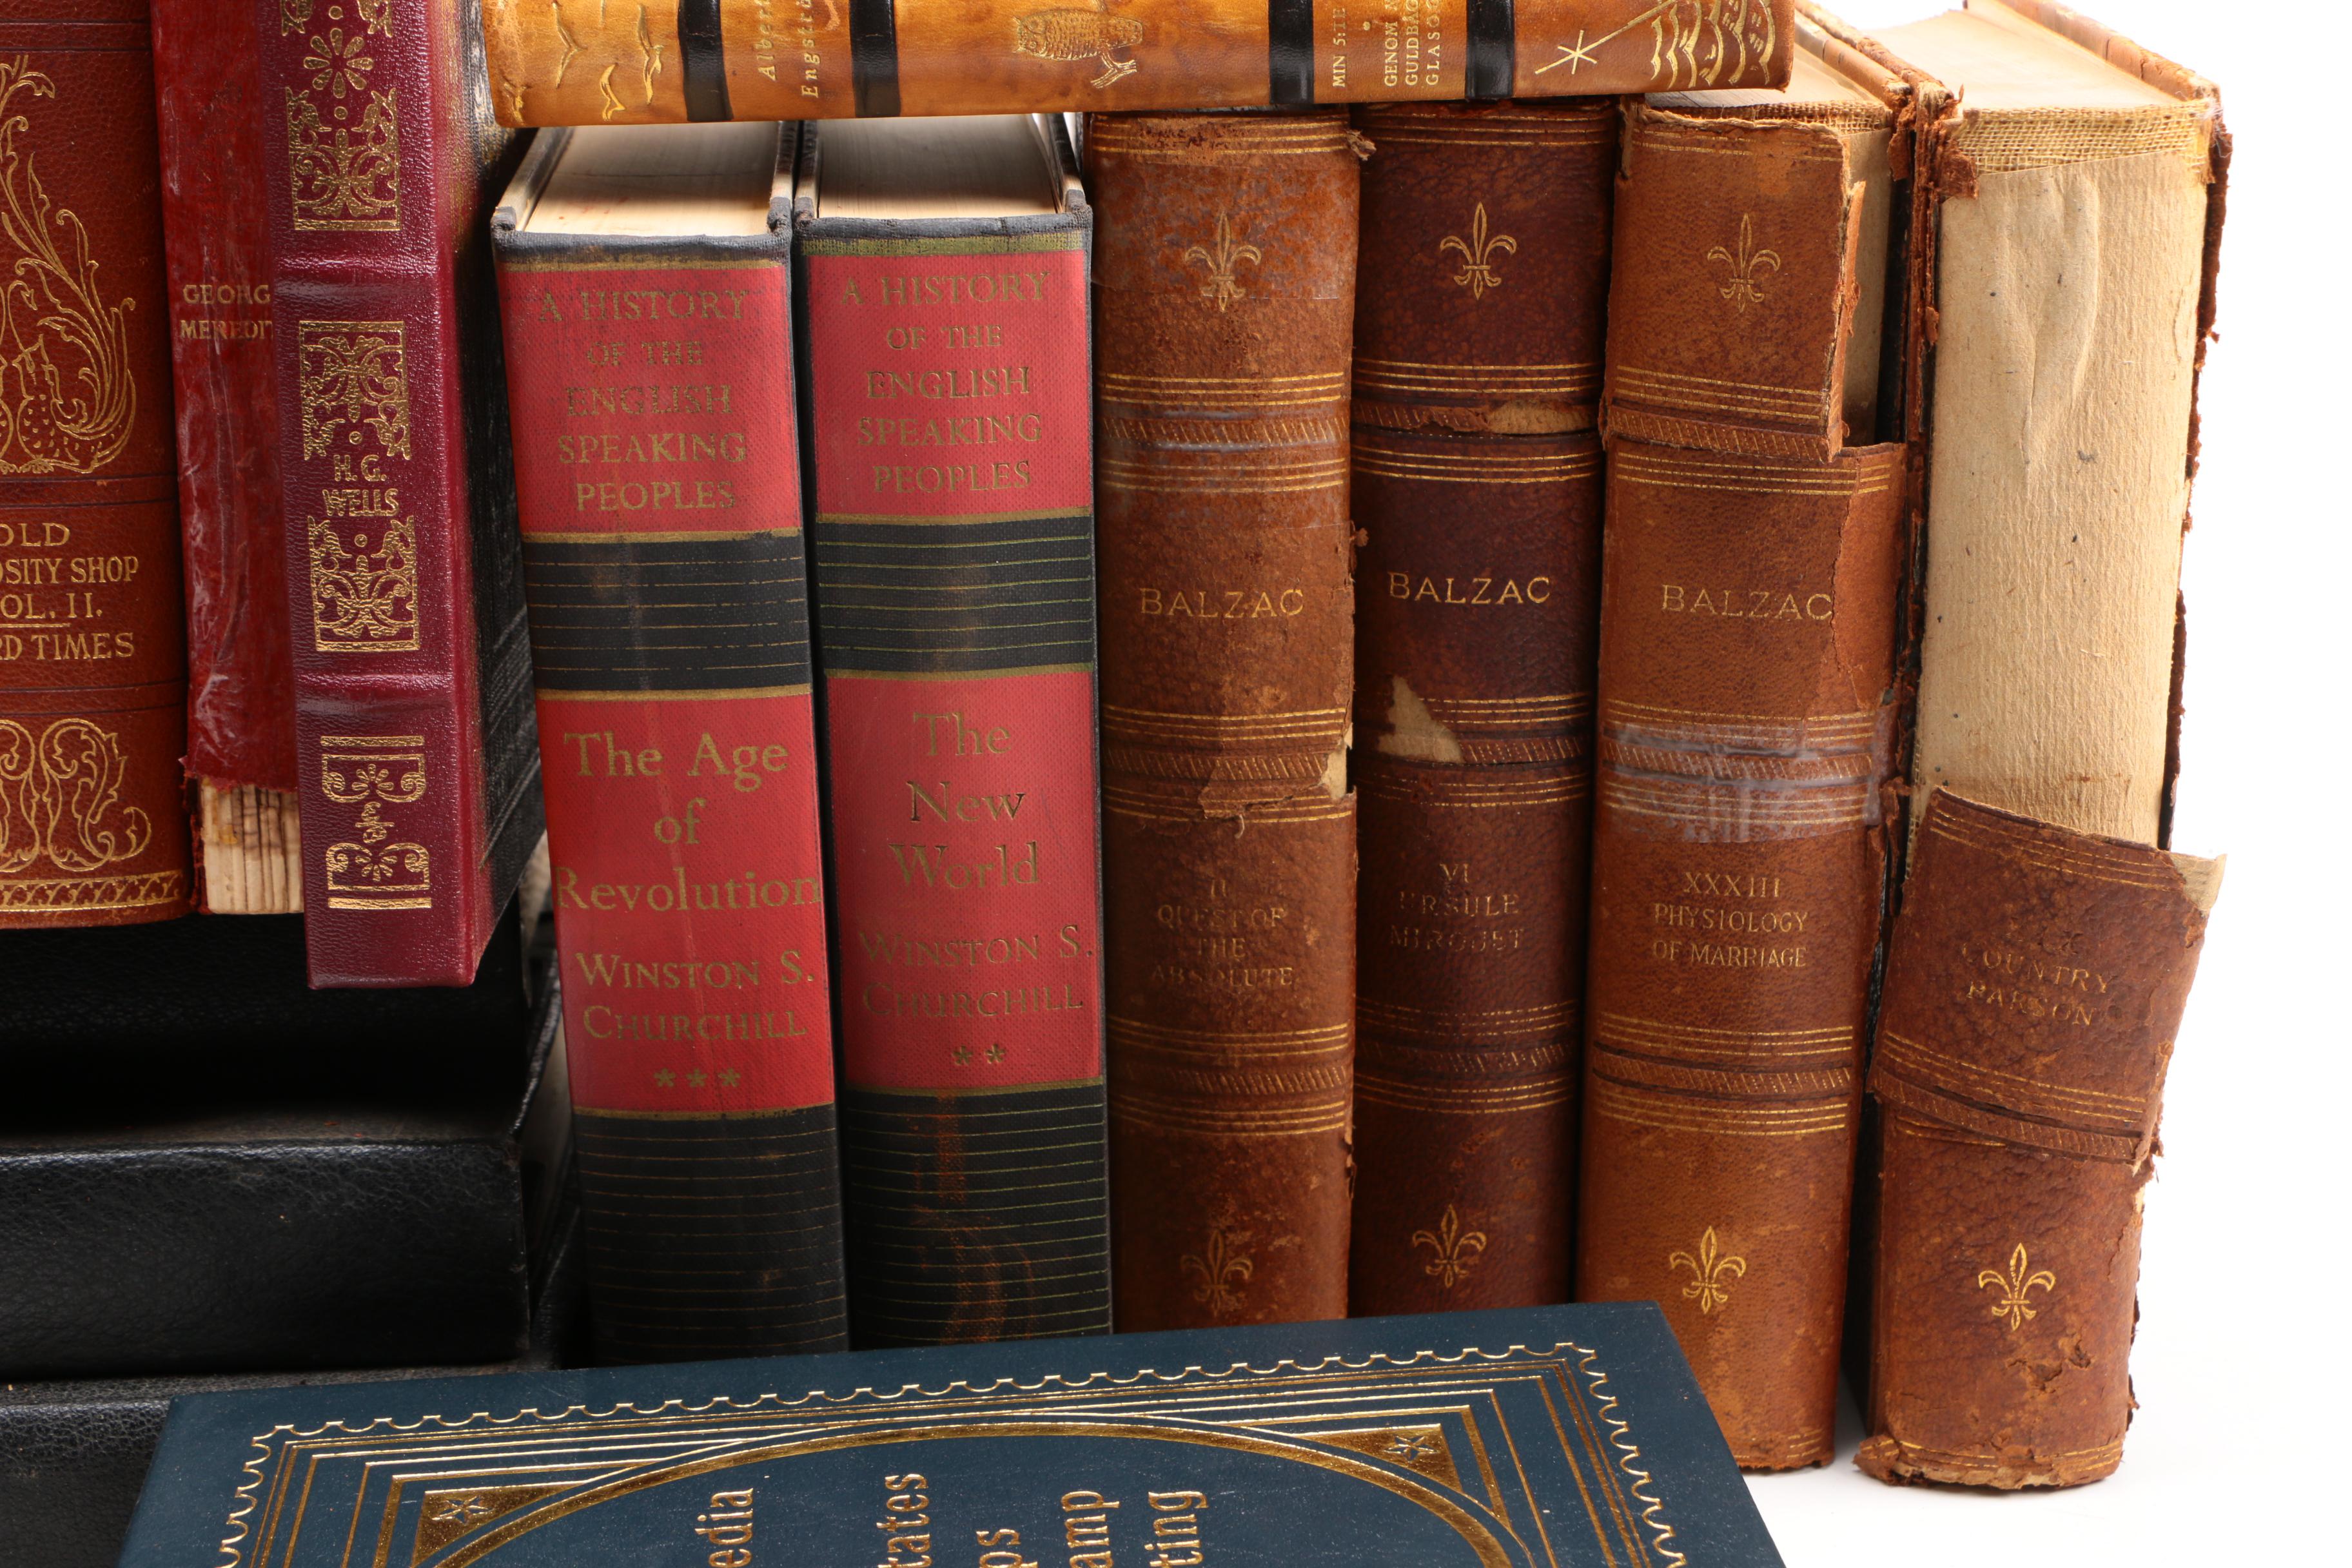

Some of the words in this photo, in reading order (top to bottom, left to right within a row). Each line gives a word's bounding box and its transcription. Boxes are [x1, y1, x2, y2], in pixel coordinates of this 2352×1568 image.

[1384, 21, 1398, 87] GENOM
[1332, 55, 1346, 88] MIN
[841, 277, 865, 306] A
[881, 271, 1050, 305] HISTORY
[539, 291, 564, 322] A
[580, 289, 749, 321] HISTORY
[586, 340, 627, 366] OF
[641, 340, 703, 366] THE
[887, 326, 926, 350] OF
[941, 324, 1003, 349] THE
[867, 366, 1031, 399] ENGLISH
[567, 384, 734, 416] ENGLISH
[858, 412, 1043, 446] SPEAKING
[557, 432, 749, 464] SPEAKING
[872, 459, 1032, 493] PEOPLES
[322, 488, 399, 516] WELLS
[576, 480, 736, 511] PEOPLES
[0, 558, 63, 584] SITY
[70, 556, 139, 583] SHOP
[1139, 587, 1304, 618] BALZAC
[1387, 571, 1551, 605] BALZAC
[1661, 584, 1833, 621] BALZAC
[66, 592, 103, 618] II.
[0, 634, 23, 660] D
[31, 632, 135, 660] TIMES
[913, 710, 1012, 757] The
[563, 730, 664, 776] The
[687, 732, 789, 792] Age
[906, 780, 1026, 823] New
[654, 797, 707, 845] of
[888, 840, 1040, 889] World
[1439, 863, 1471, 884] VI
[554, 866, 823, 912] Revolution
[1683, 871, 1781, 898] XXXIII
[1250, 906, 1286, 928] OF
[1653, 902, 1808, 934] PHYSIOLOGY
[1059, 923, 1093, 959] S.
[1652, 939, 1682, 961] OF
[1690, 943, 1807, 968] MARRIAGE
[779, 949, 816, 985] S.
